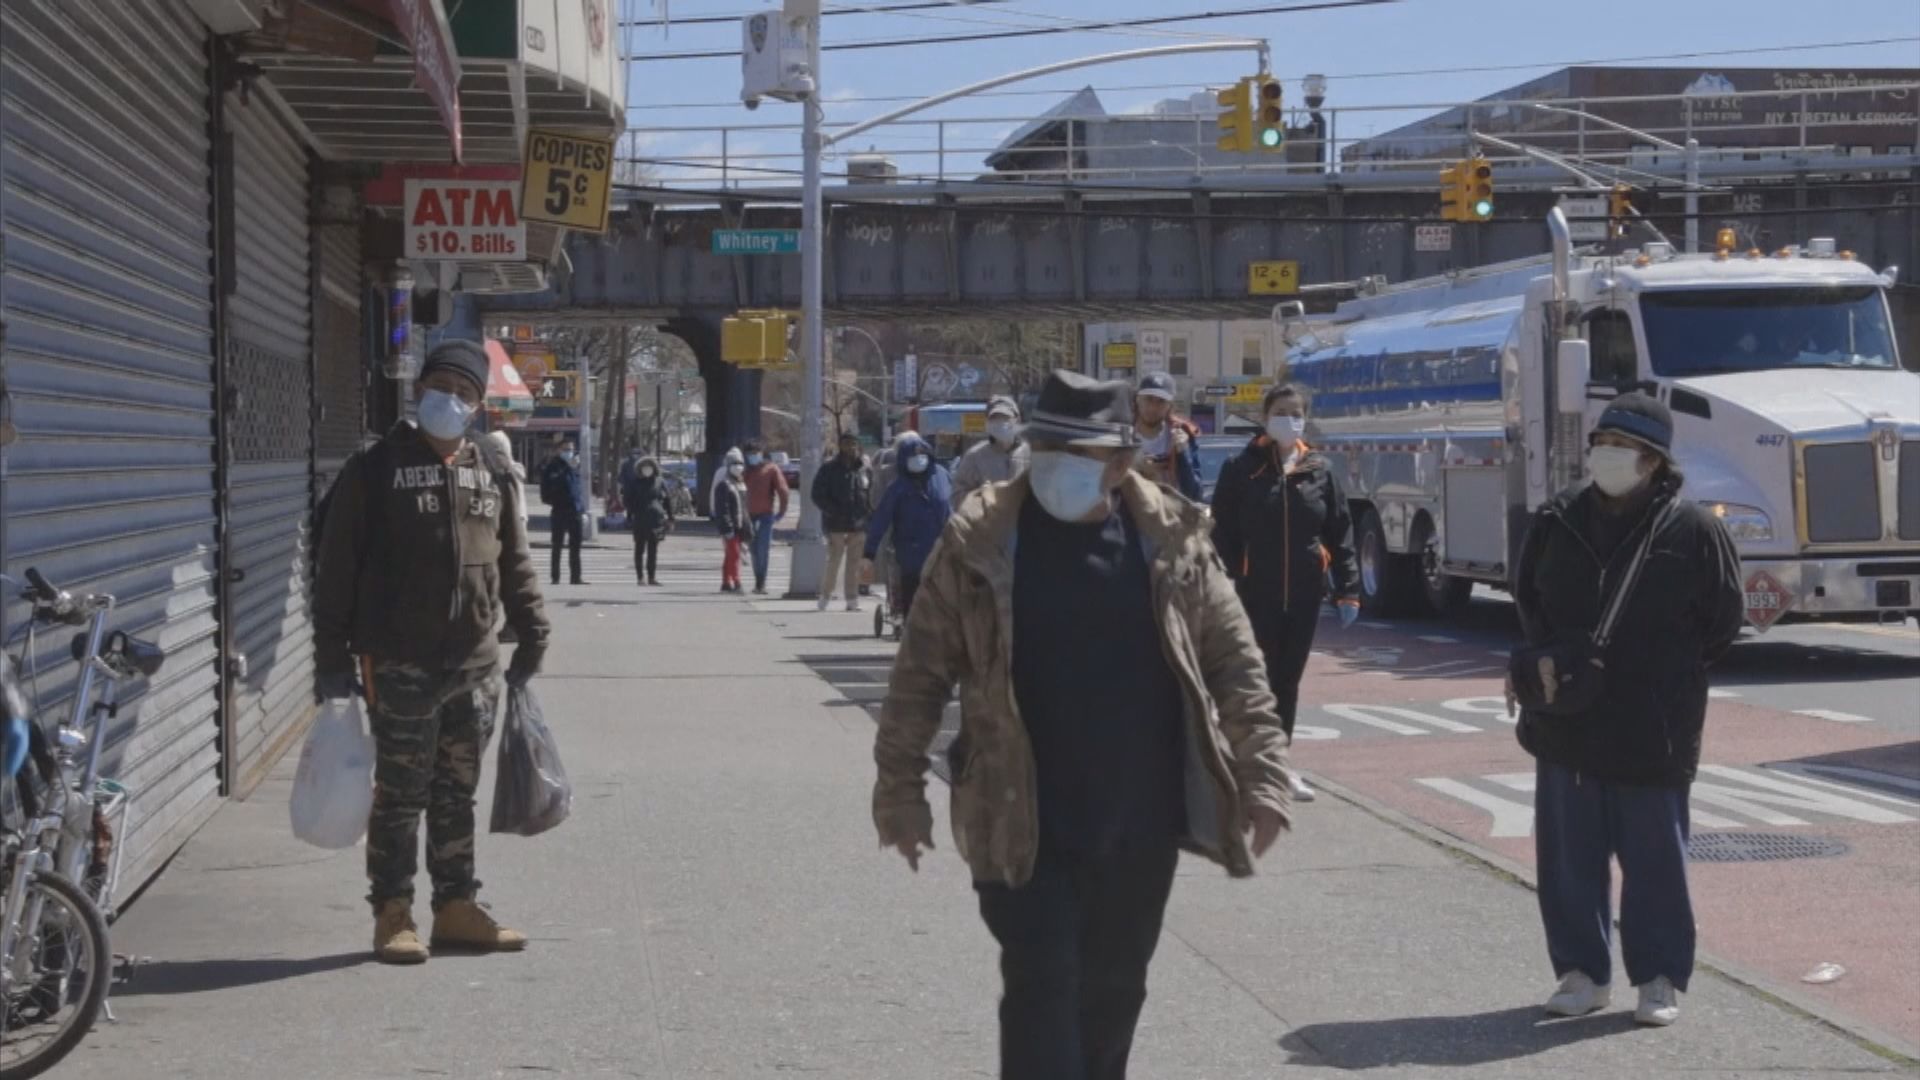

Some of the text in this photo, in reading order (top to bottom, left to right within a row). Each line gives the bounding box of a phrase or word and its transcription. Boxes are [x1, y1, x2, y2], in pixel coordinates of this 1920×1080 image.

[532, 136, 605, 171] COPIES
[413, 188, 517, 227] ATM
[471, 234, 515, 254] Bills
[719, 233, 779, 252] Whitney
